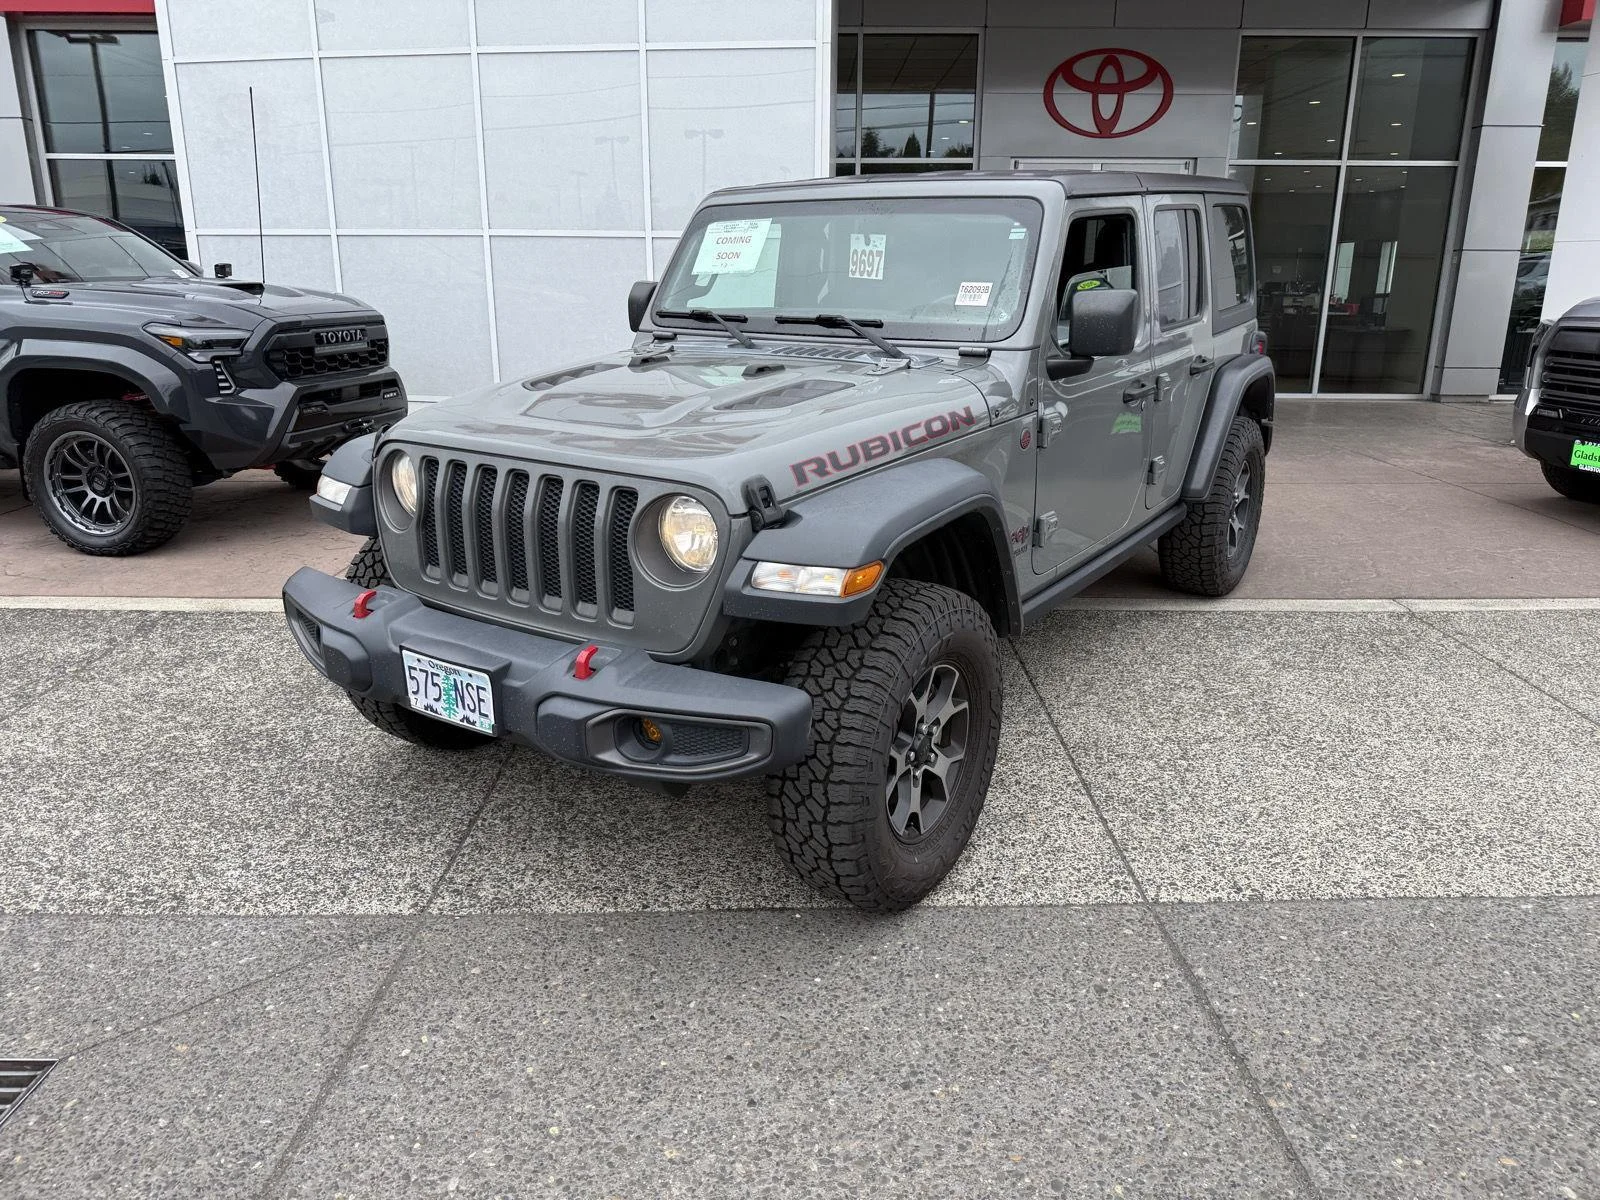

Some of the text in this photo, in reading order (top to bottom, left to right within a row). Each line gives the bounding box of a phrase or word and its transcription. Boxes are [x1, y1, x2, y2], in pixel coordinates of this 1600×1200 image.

[716, 236, 752, 245] COMING
[716, 252, 741, 260] SOON
[851, 249, 884, 278] 9697
[320, 329, 364, 343] TOYOTA
[790, 406, 976, 487] RUBICON
[428, 660, 461, 676] Oregon
[408, 665, 488, 718] 575 NSE
